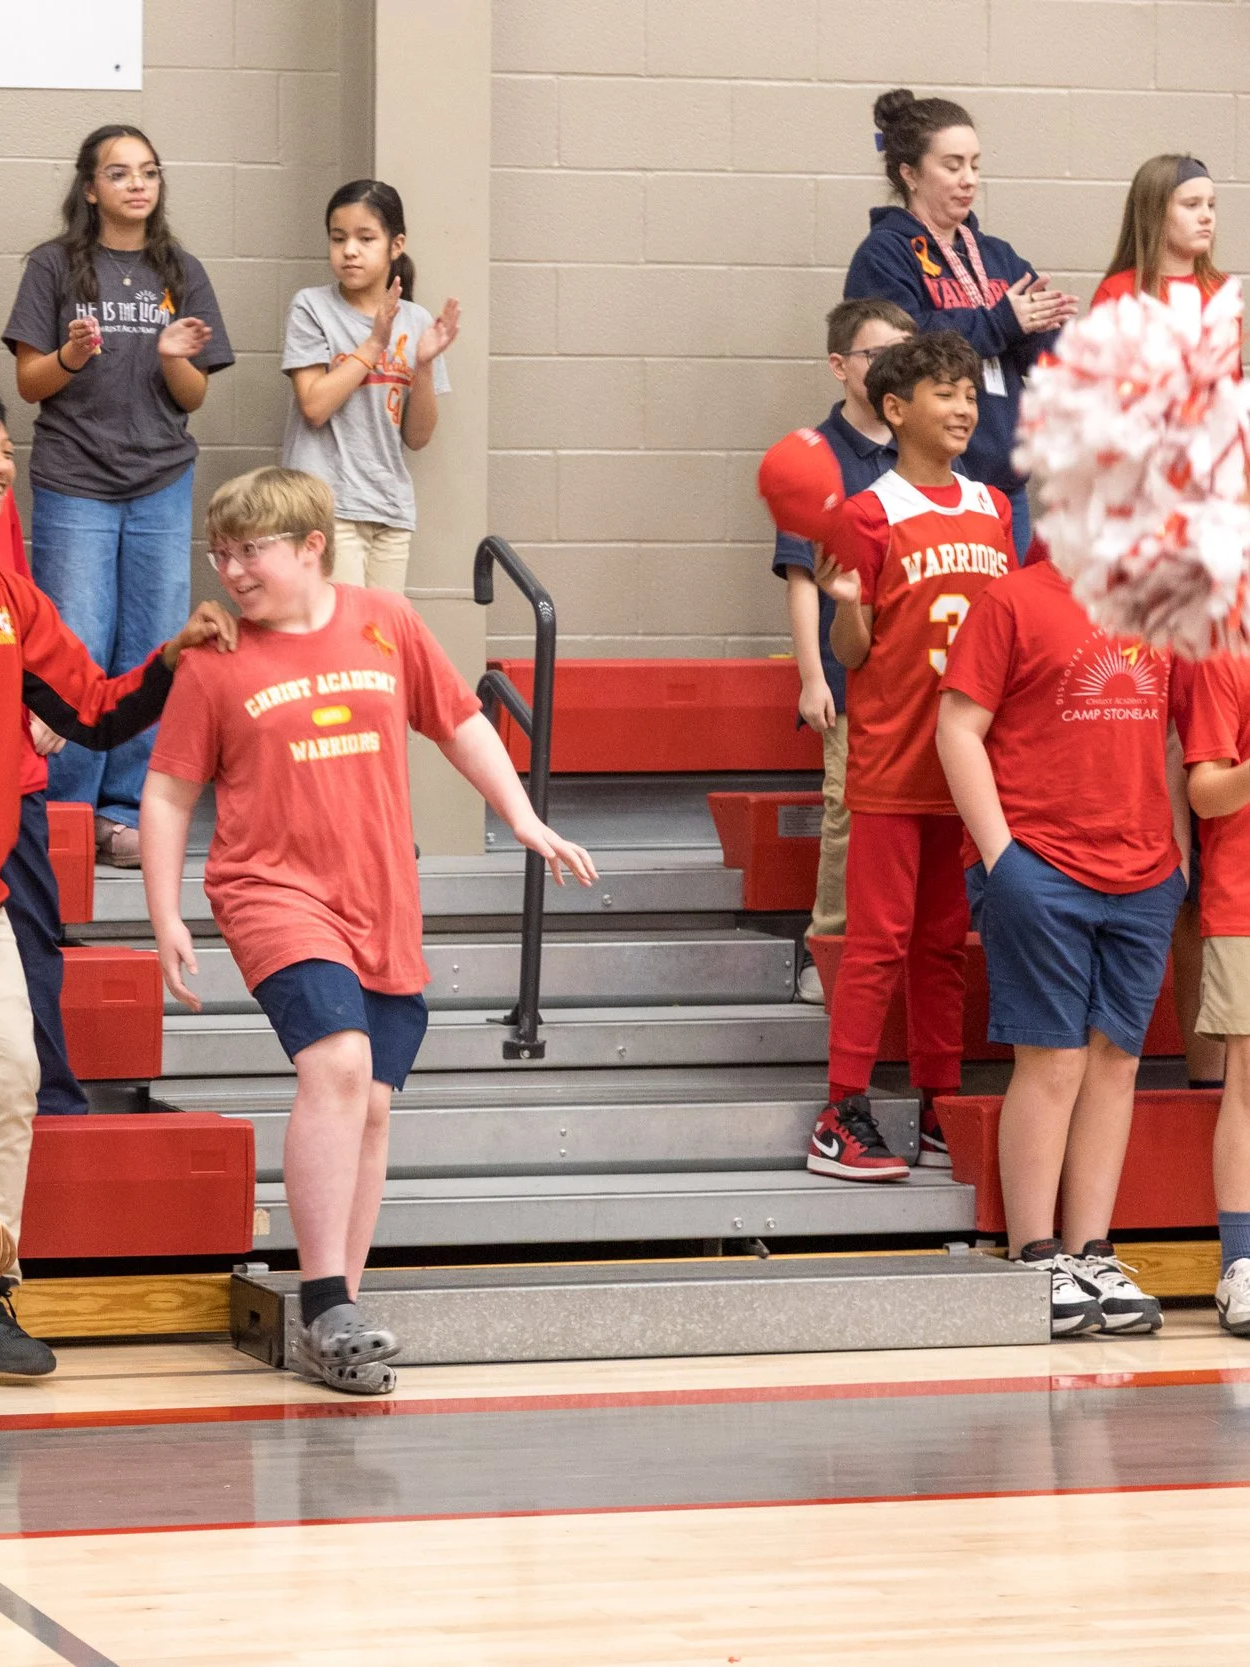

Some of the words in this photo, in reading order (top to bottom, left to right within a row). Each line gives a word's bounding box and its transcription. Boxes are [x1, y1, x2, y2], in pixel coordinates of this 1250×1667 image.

[102, 301, 116, 321] IS
[117, 302, 137, 322] THE
[901, 542, 1008, 585] WARRIORS
[244, 676, 312, 719] CHRIST
[316, 669, 397, 696] ACADEMY
[1061, 708, 1101, 722] CAMP
[1103, 707, 1159, 721] STONELAK
[288, 730, 381, 763] WARRIORS
